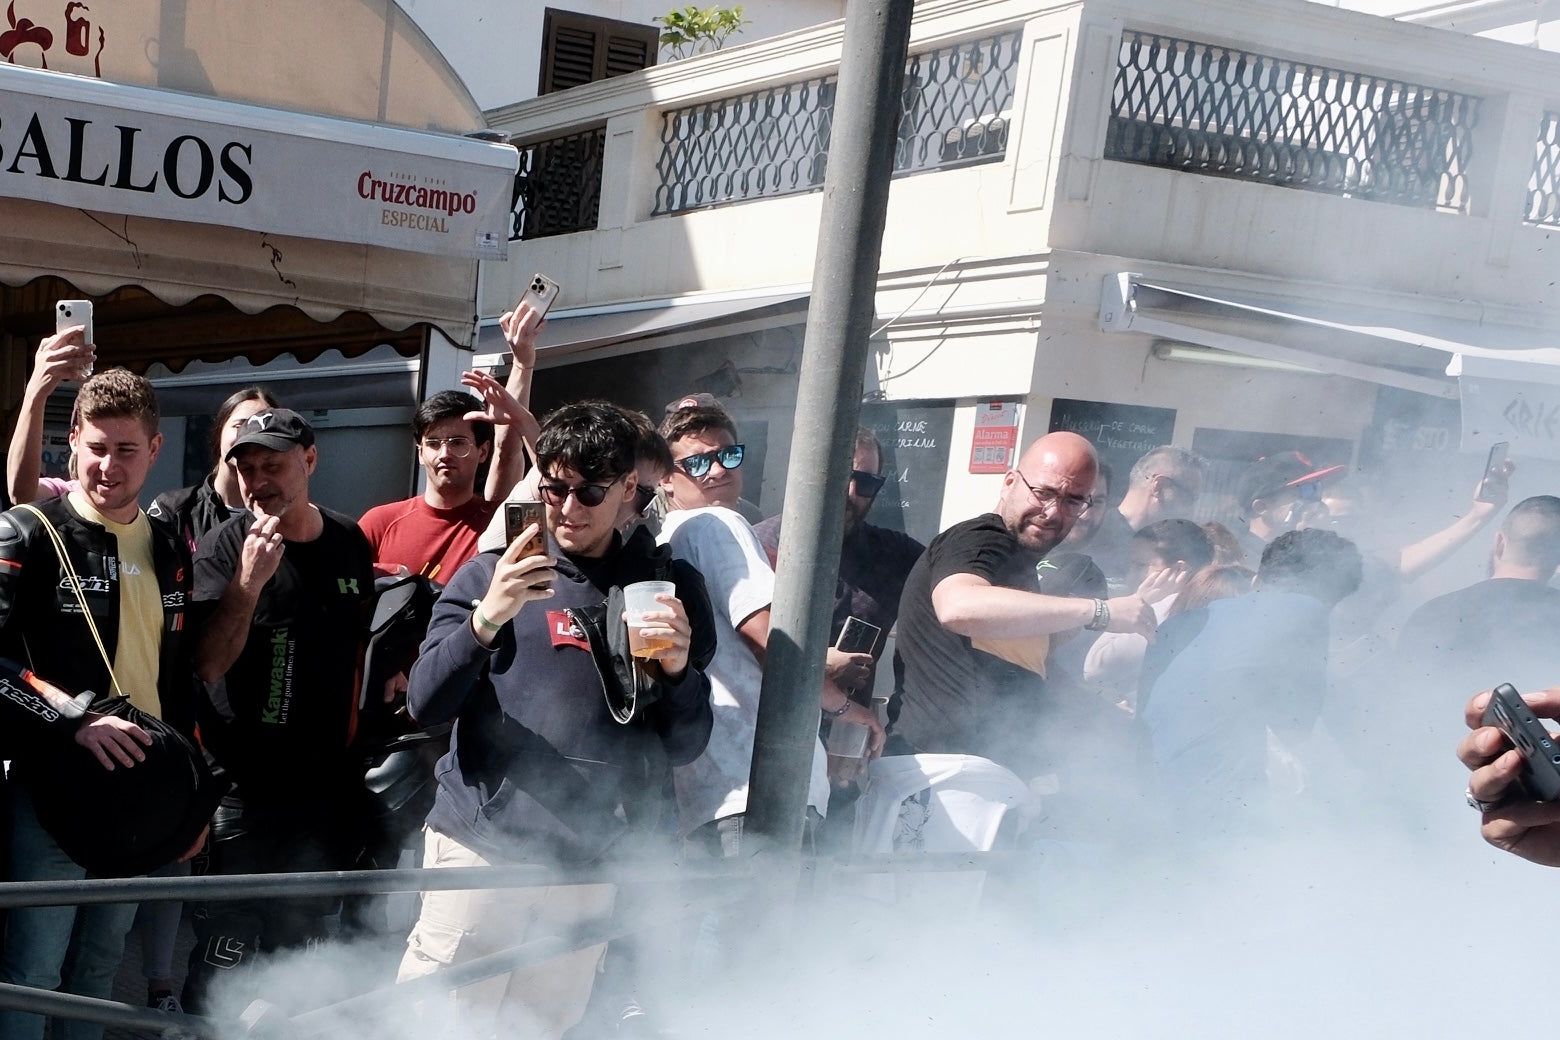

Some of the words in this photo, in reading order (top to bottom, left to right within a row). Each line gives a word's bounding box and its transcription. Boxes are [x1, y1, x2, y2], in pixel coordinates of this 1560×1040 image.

[357, 170, 476, 216] Cruzcampo
[381, 209, 449, 234] ESPECIAL
[975, 429, 1009, 440] Alarma
[261, 627, 289, 724] Kawasaki
[282, 699, 290, 711] the
